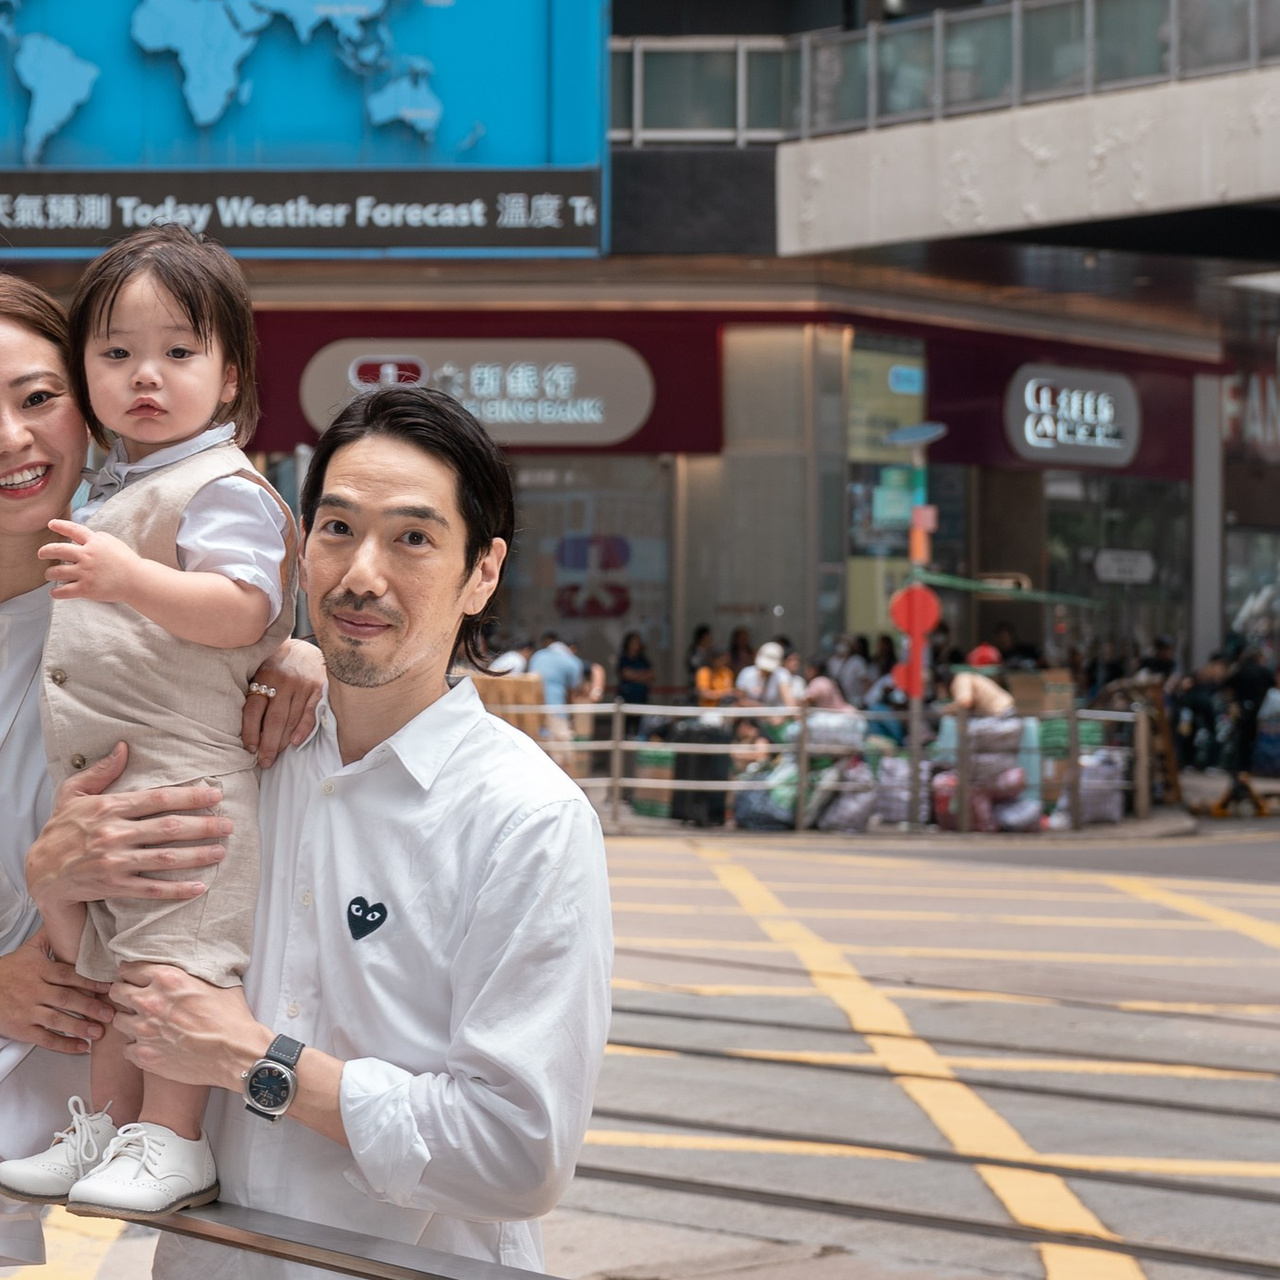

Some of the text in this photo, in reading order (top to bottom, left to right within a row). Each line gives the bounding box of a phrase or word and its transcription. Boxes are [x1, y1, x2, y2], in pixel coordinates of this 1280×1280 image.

[115, 195, 213, 233] Today
[216, 195, 351, 228] Weather
[355, 195, 488, 228] Forecast
